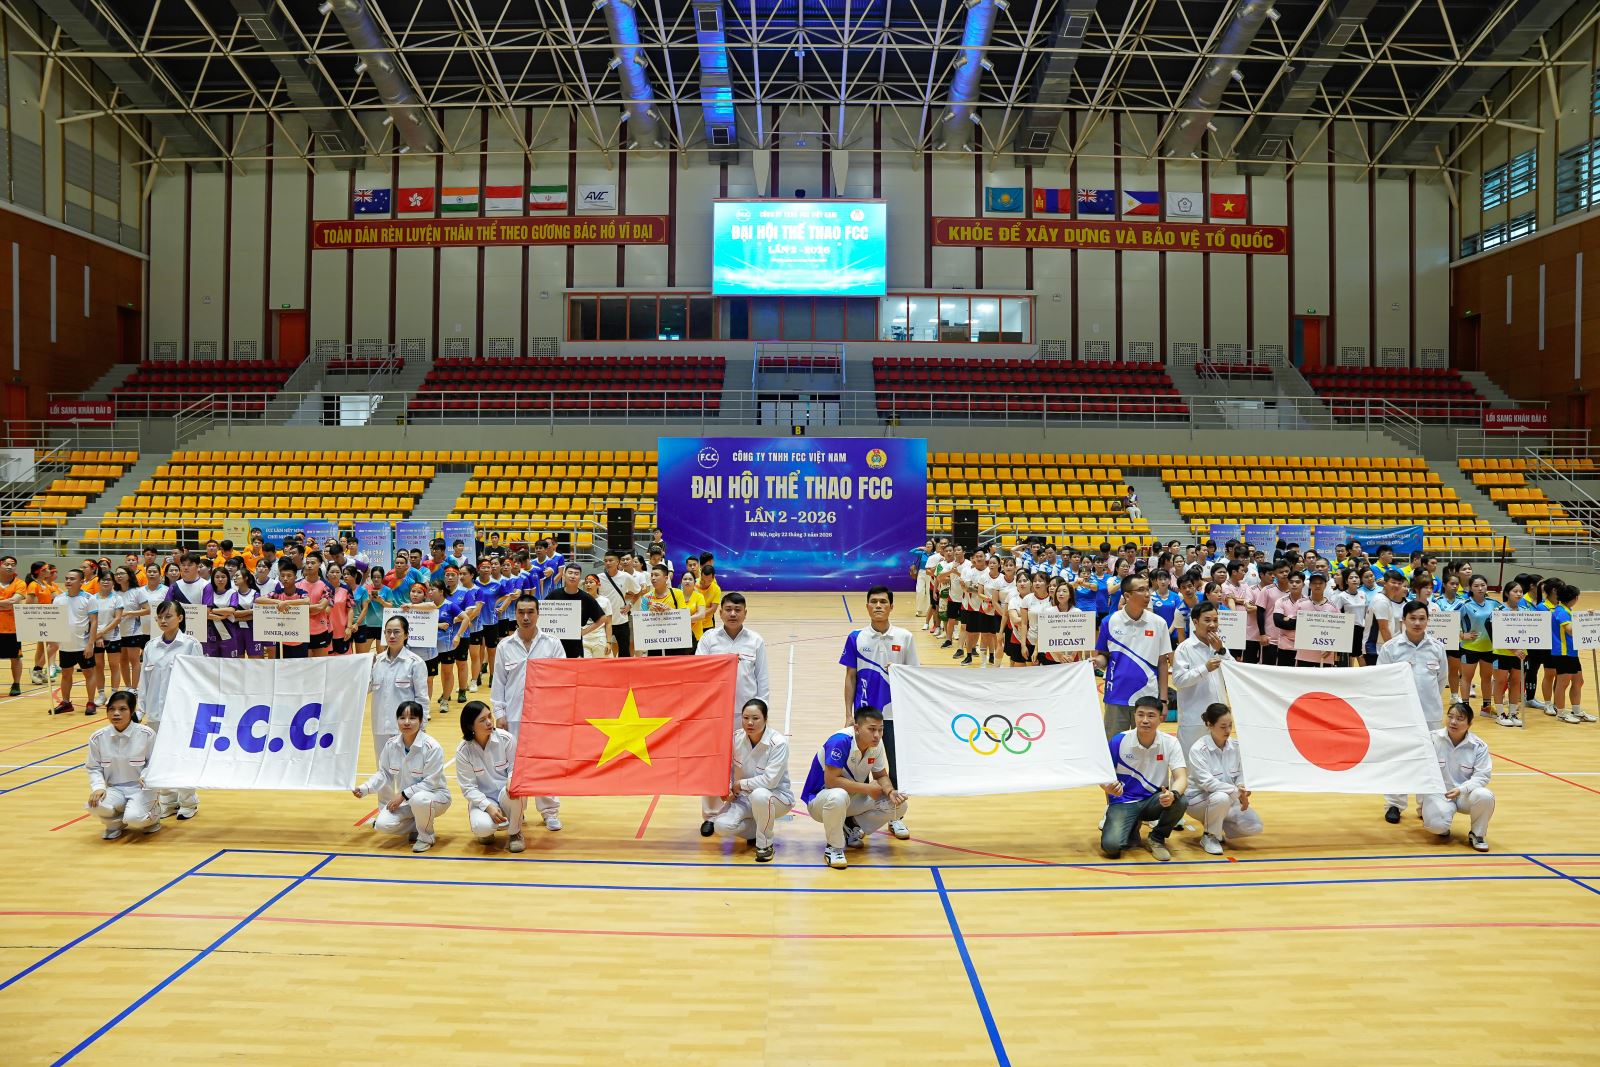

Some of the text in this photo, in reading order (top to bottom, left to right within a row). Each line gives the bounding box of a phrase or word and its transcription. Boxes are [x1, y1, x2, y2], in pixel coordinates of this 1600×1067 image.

[584, 191, 609, 200] AVC
[324, 219, 653, 245] TOÀN DÂN RÈN LUYỆN THÂN THỂ THEO GƯƠNG BÁC HỒ VĨ ĐẠI
[757, 222, 778, 242] HỘI
[808, 225, 841, 241] THAO
[845, 225, 869, 240] FCC
[949, 221, 1274, 249] KHỎE ĐỂ XÂY DỰNG VÀ BẢO VỆ TỔ QUỐC
[1496, 414, 1513, 422] SANG
[795, 427, 801, 435] B
[732, 450, 847, 464] CÔNG TY TNHH FCC VIỆT NAM
[691, 469, 893, 504] ĐẠI HỘI THỂ THAO FCC
[745, 506, 776, 523] LẦN
[778, 511, 788, 523] 2
[1048, 638, 1086, 646] DIECAST
[189, 702, 334, 754] F.C.C.
